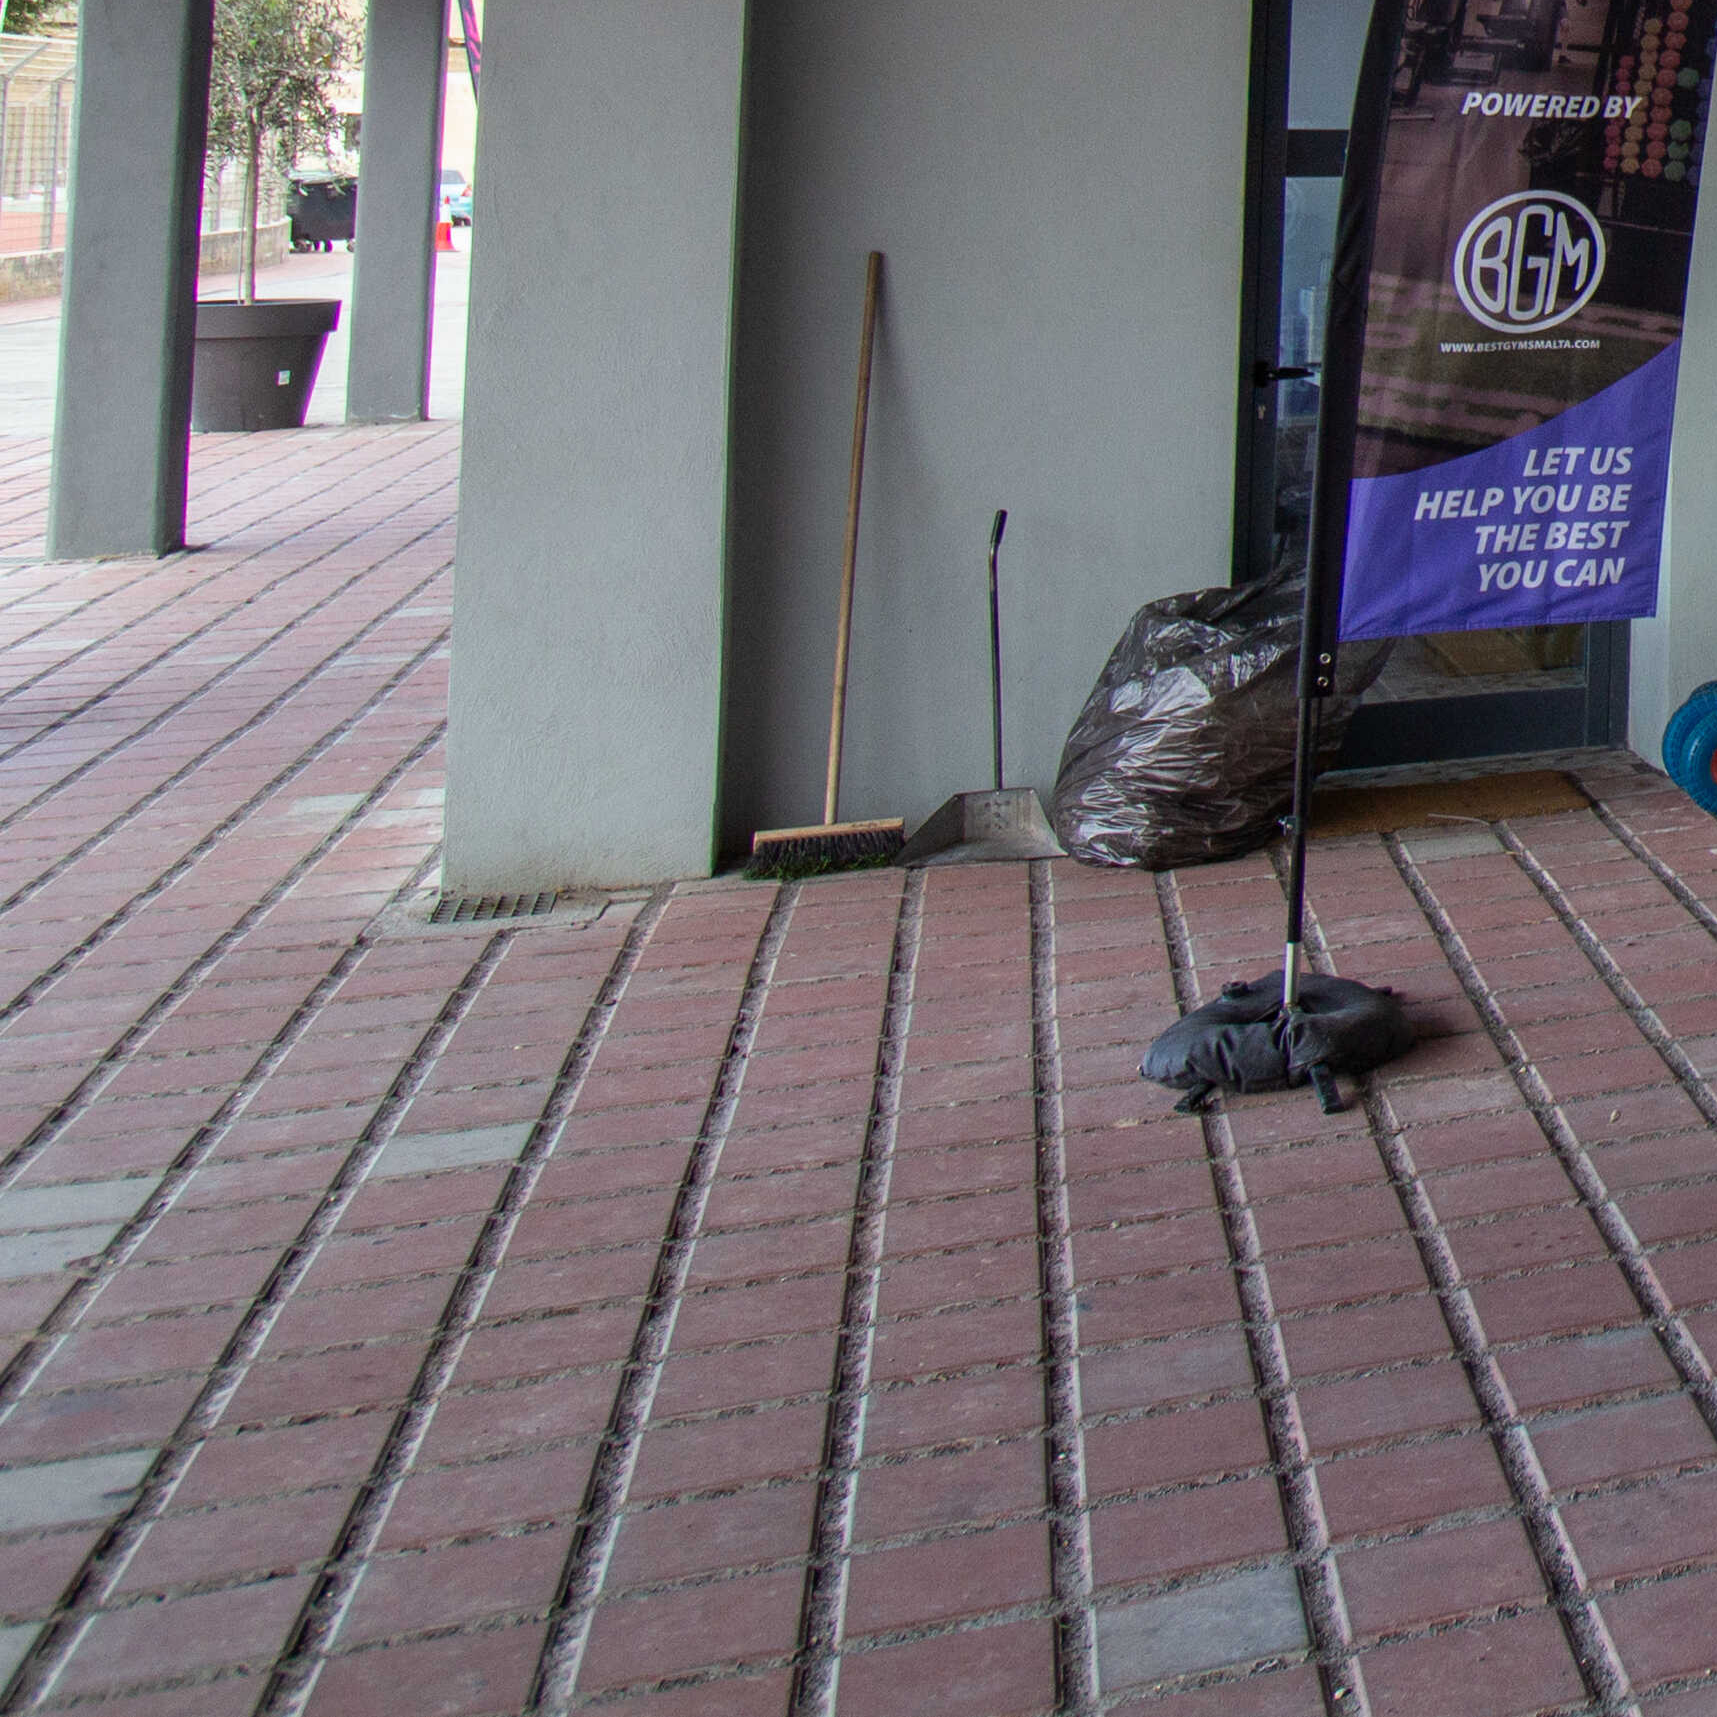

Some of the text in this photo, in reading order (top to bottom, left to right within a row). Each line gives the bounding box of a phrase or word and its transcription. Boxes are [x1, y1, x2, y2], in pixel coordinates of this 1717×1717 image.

[1461, 92, 1643, 119] POWERED BY
[1470, 204, 1590, 321] BGM
[1440, 339, 1600, 353] WWW.BESTGYMSMALTA.COM
[1523, 447, 1634, 477] LET US
[1414, 484, 1633, 521] HELP YOU BE
[1475, 521, 1631, 555] THE BEST
[1479, 557, 1626, 592] YOU CAN
